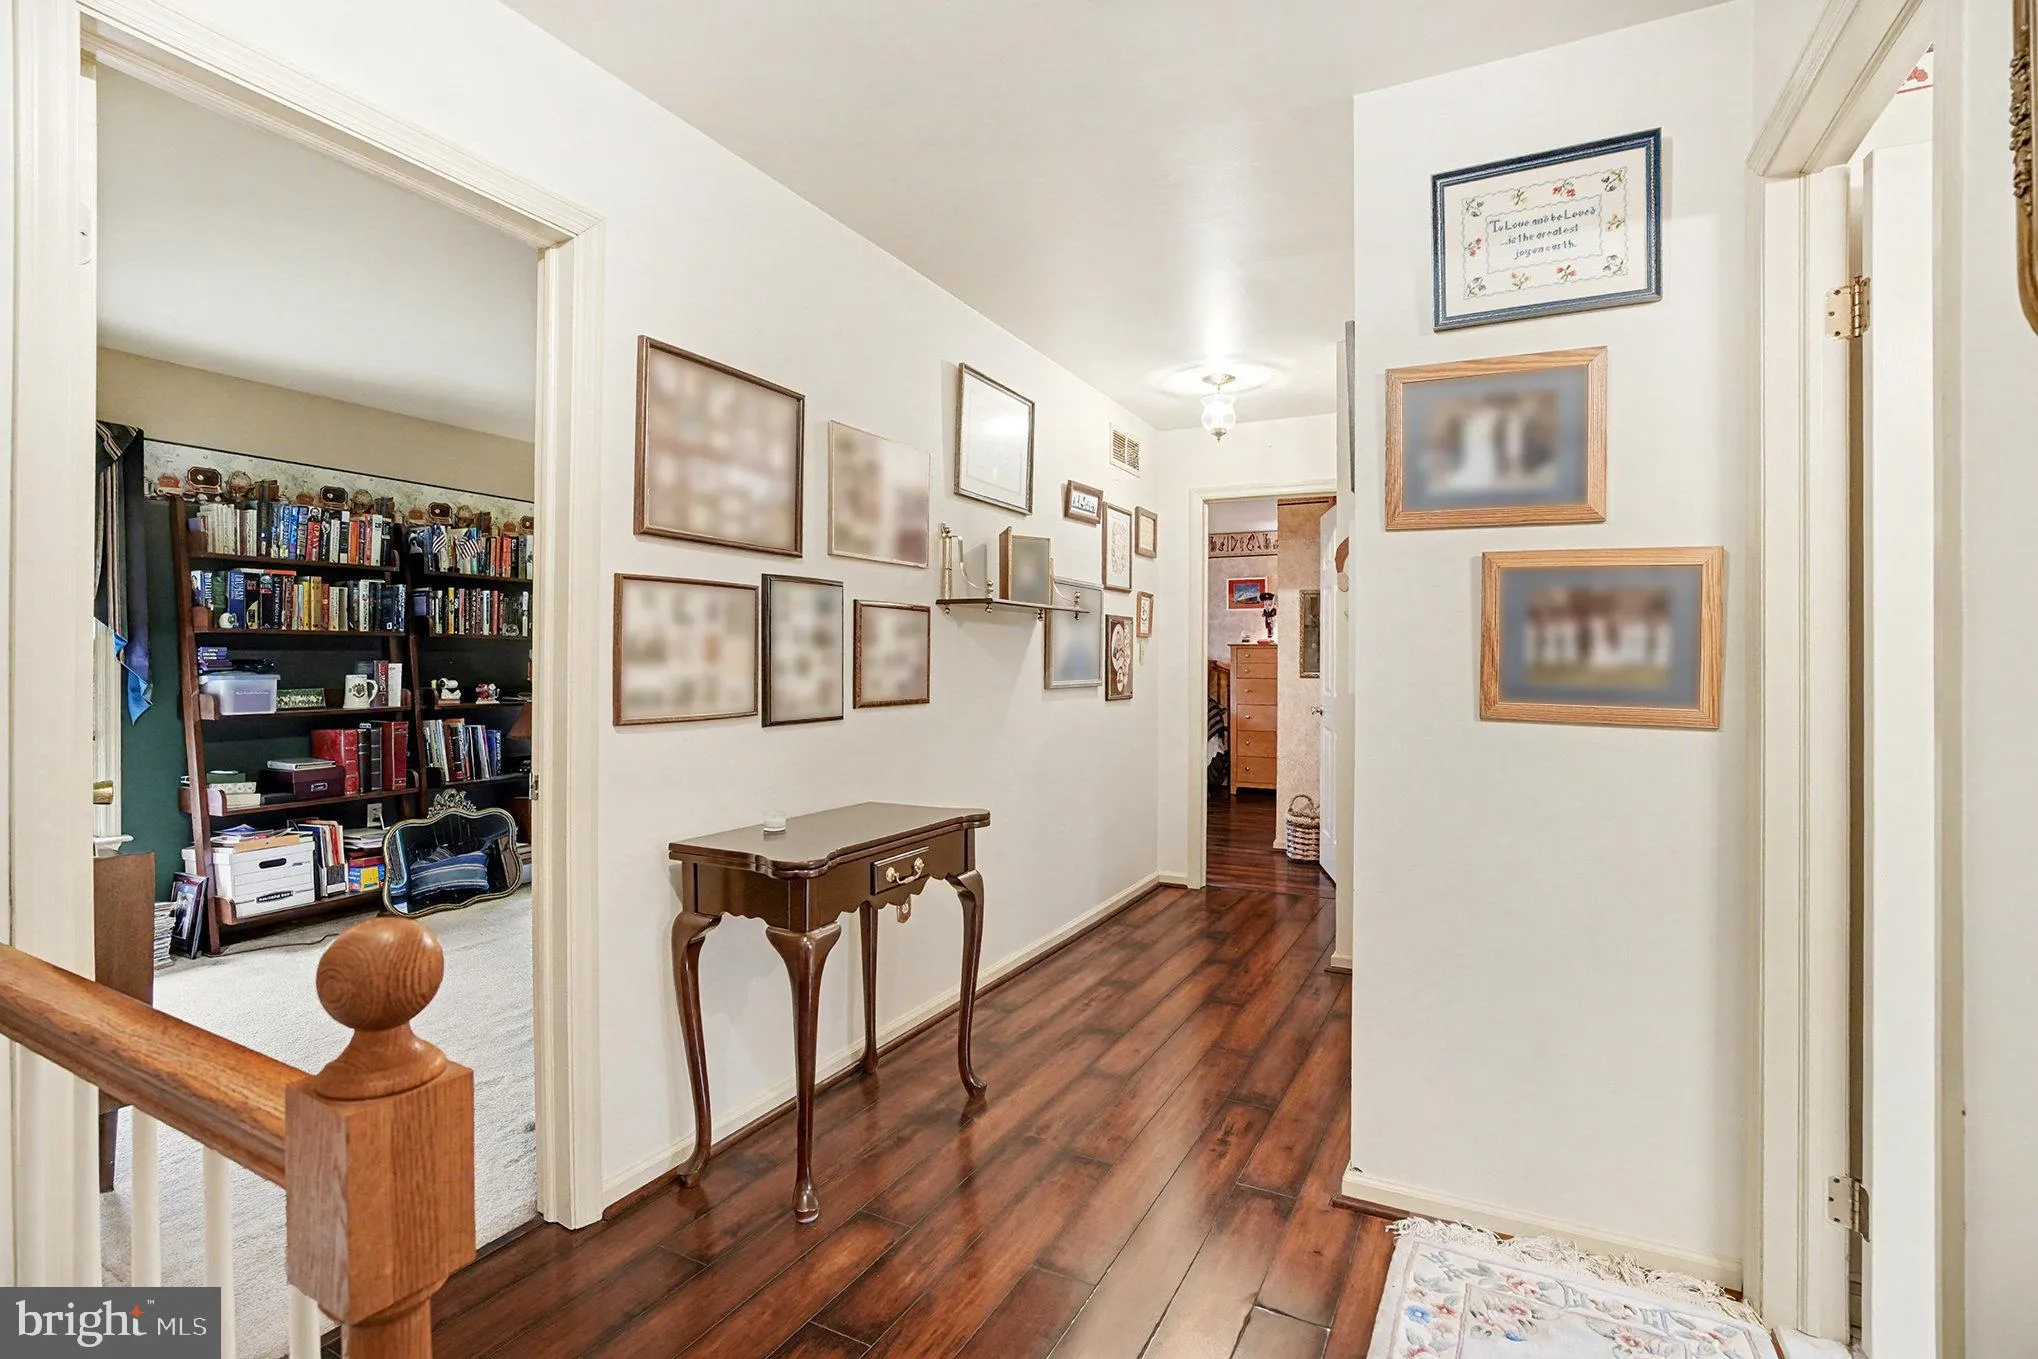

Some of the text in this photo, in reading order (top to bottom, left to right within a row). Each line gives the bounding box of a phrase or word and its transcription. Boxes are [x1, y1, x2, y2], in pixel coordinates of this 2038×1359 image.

[1489, 206, 1596, 233] To Love and be Loved
[1517, 232, 1534, 241] the
[1514, 247, 1531, 260] joy
[1533, 245, 1544, 254] on
